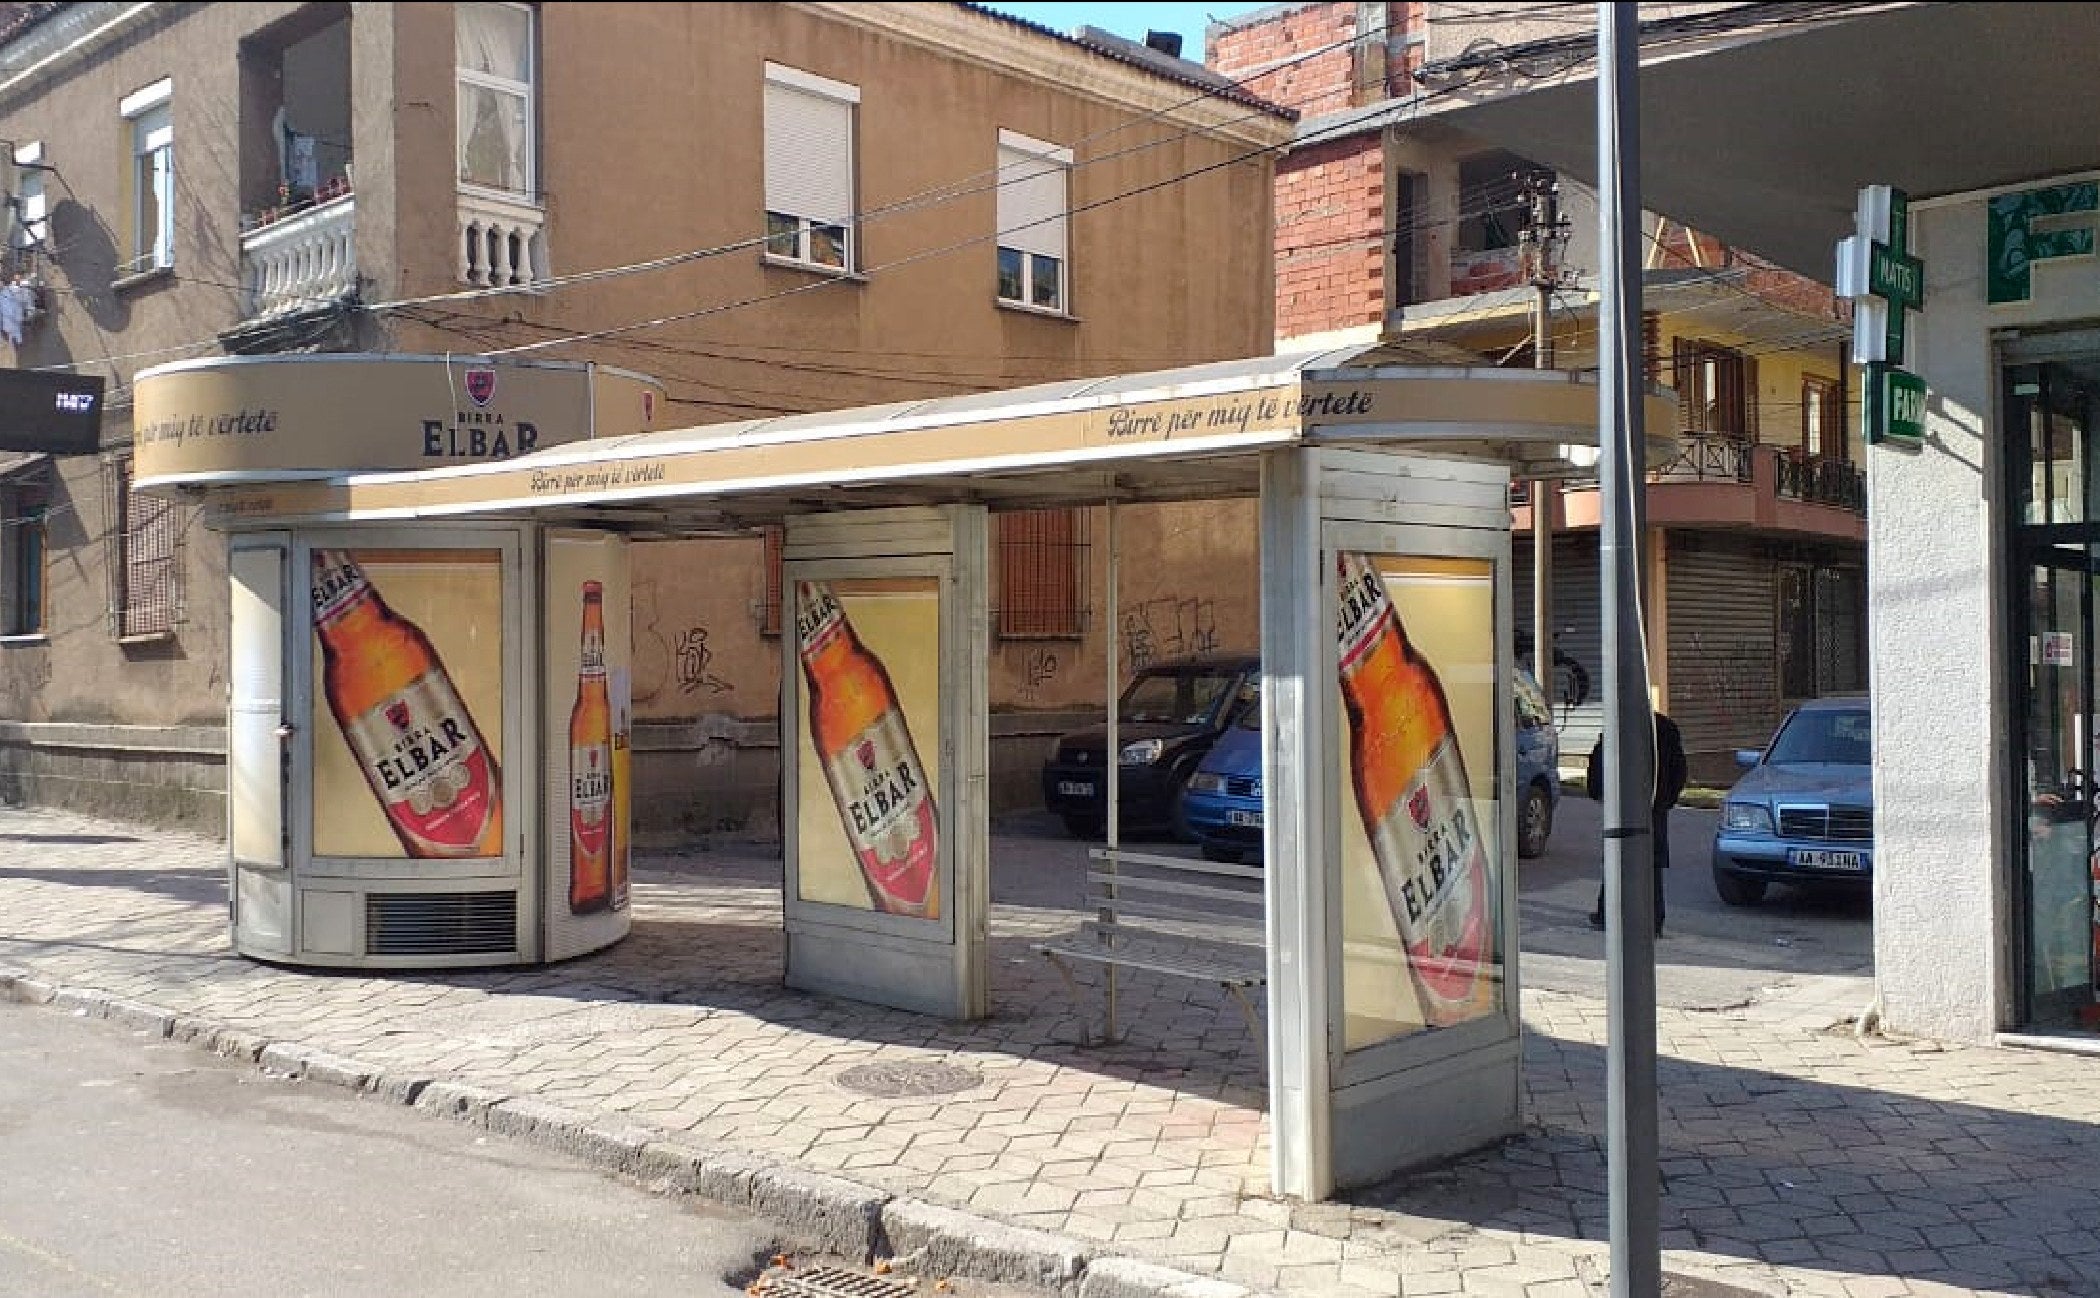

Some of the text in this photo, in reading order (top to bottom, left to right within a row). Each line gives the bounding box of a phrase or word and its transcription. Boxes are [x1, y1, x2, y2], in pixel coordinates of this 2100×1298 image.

[421, 419, 539, 459] ELBAR
[376, 718, 467, 790] ELBAR
[848, 761, 917, 835] ELBAR
[1401, 808, 1471, 925] ELBAR
